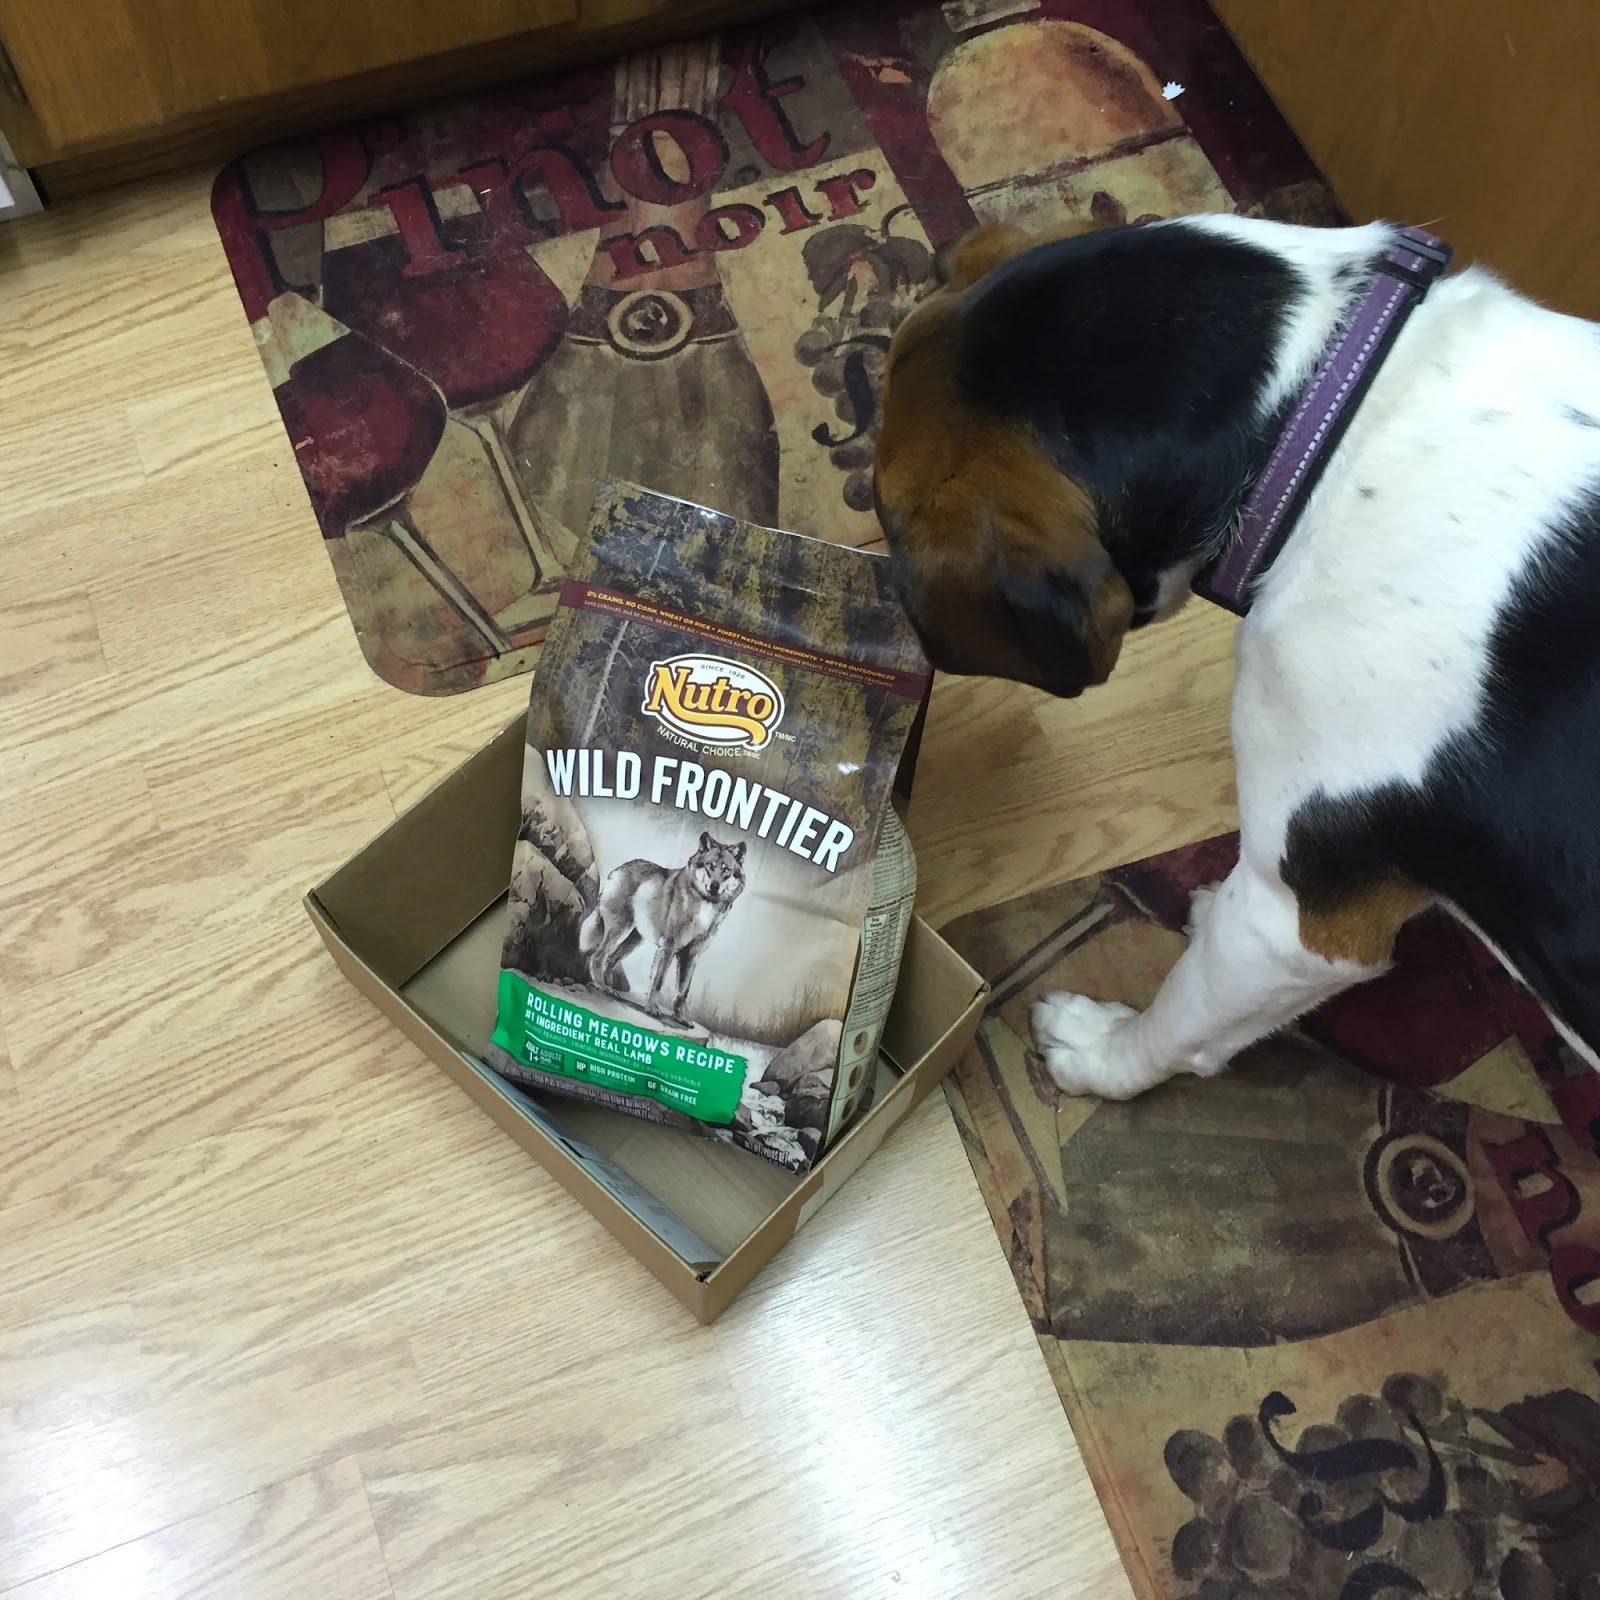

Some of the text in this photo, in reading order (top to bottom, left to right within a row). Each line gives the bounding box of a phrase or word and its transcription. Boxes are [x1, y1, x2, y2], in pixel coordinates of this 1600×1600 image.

[211, 26, 831, 320] Pinot
[597, 165, 876, 282] noir
[625, 600, 636, 608] NO
[659, 610, 683, 623] WHEAT
[683, 617, 694, 626] OR
[694, 621, 711, 631] RICE
[716, 628, 741, 639] FINEST
[740, 634, 772, 649] NATURAL
[772, 645, 818, 661] INGREDIENTS
[825, 658, 848, 669] NEVER
[848, 664, 896, 681] OUTSOURCED
[700, 664, 725, 673] SINCE
[645, 665, 774, 738] Nutro
[657, 725, 699, 752] NATURAL
[702, 745, 742, 757] CHOICE
[546, 748, 642, 799] WILD
[651, 755, 855, 874] FRONTIER
[525, 1009, 535, 1022] #1
[536, 1015, 591, 1044] INGREDIENT
[594, 1037, 620, 1054] REAL
[623, 1047, 652, 1064] LAMB
[527, 992, 583, 1028] ROLLING
[588, 1018, 670, 1056] MEADOWS
[675, 1046, 735, 1074] RECIPE
[529, 1052, 540, 1062] 1+
[540, 1049, 563, 1062] ADULTE
[576, 1061, 587, 1071] HP
[590, 1063, 606, 1075] HIGH
[607, 1069, 636, 1083] PROTEIN
[647, 1081, 657, 1090] GF
[660, 1084, 679, 1099] GRAIN
[680, 1093, 697, 1105] FREE
